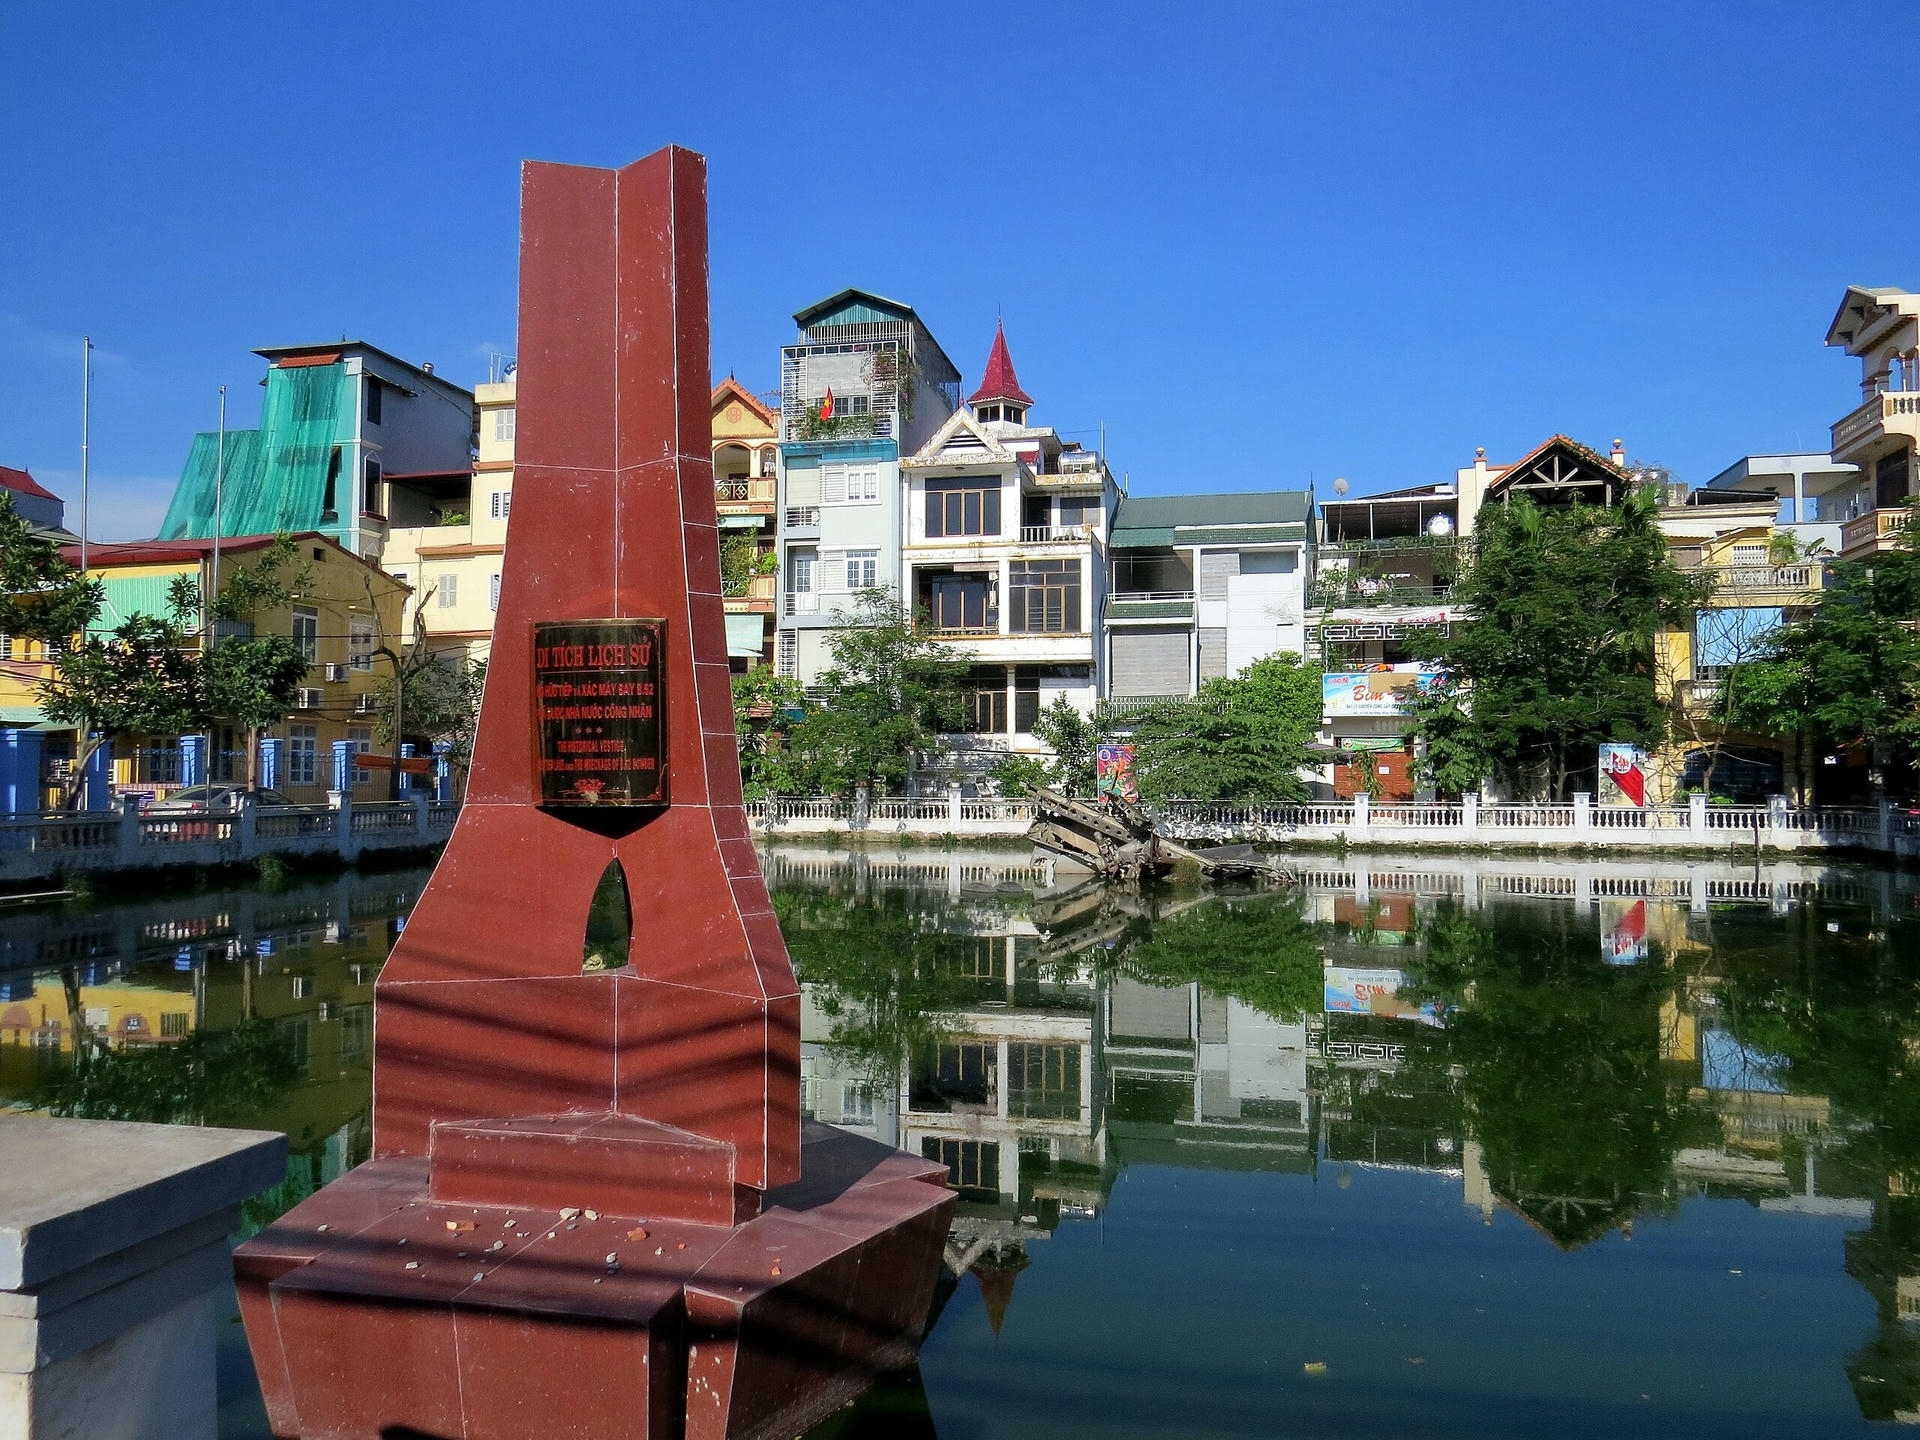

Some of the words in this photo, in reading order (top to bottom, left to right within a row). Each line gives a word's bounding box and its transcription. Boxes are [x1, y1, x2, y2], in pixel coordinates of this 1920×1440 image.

[537, 647, 549, 669] DI
[552, 640, 584, 668] TÍCH
[588, 644, 626, 671] LỊCH
[630, 635, 652, 666] SỬ
[581, 681, 598, 697] XÁC
[618, 682, 635, 696] BAY
[636, 682, 655, 696] B.52
[604, 702, 627, 720] CÔNG
[628, 702, 653, 722] NHẬN
